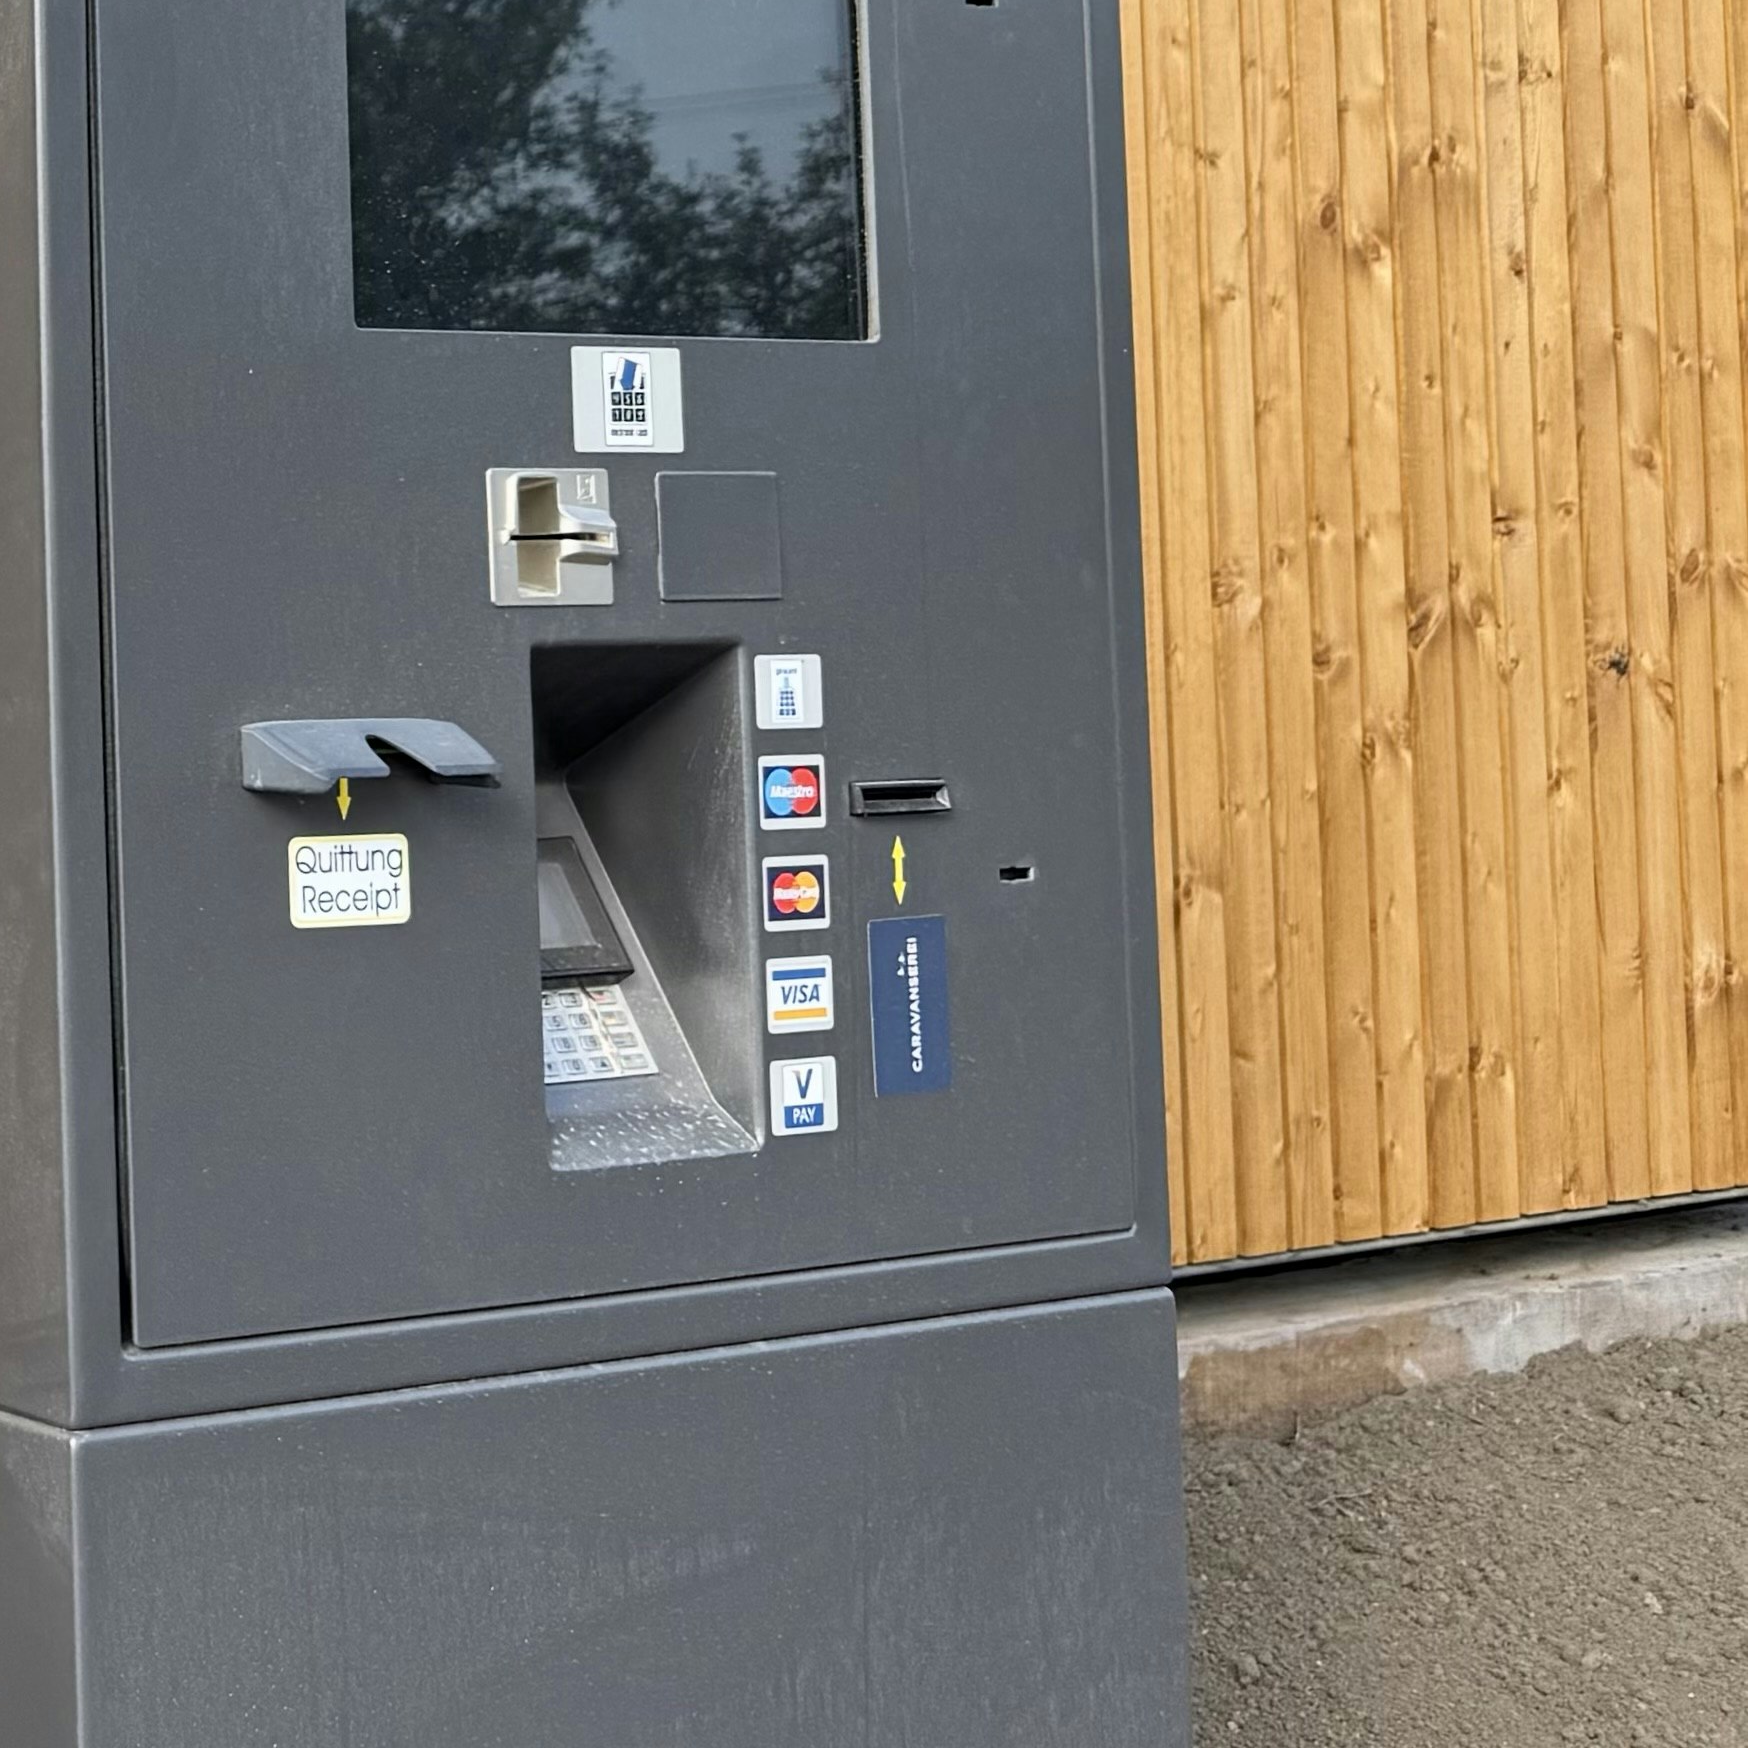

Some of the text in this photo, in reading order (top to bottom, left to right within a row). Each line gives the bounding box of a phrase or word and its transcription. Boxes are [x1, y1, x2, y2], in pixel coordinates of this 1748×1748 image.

[296, 844, 402, 877] Quittung
[302, 882, 400, 916] Receipt
[780, 983, 821, 1005] VISA
[906, 937, 923, 1073] CARAVANSEREI
[793, 1068, 813, 1099] V
[792, 1105, 815, 1125] PAY
